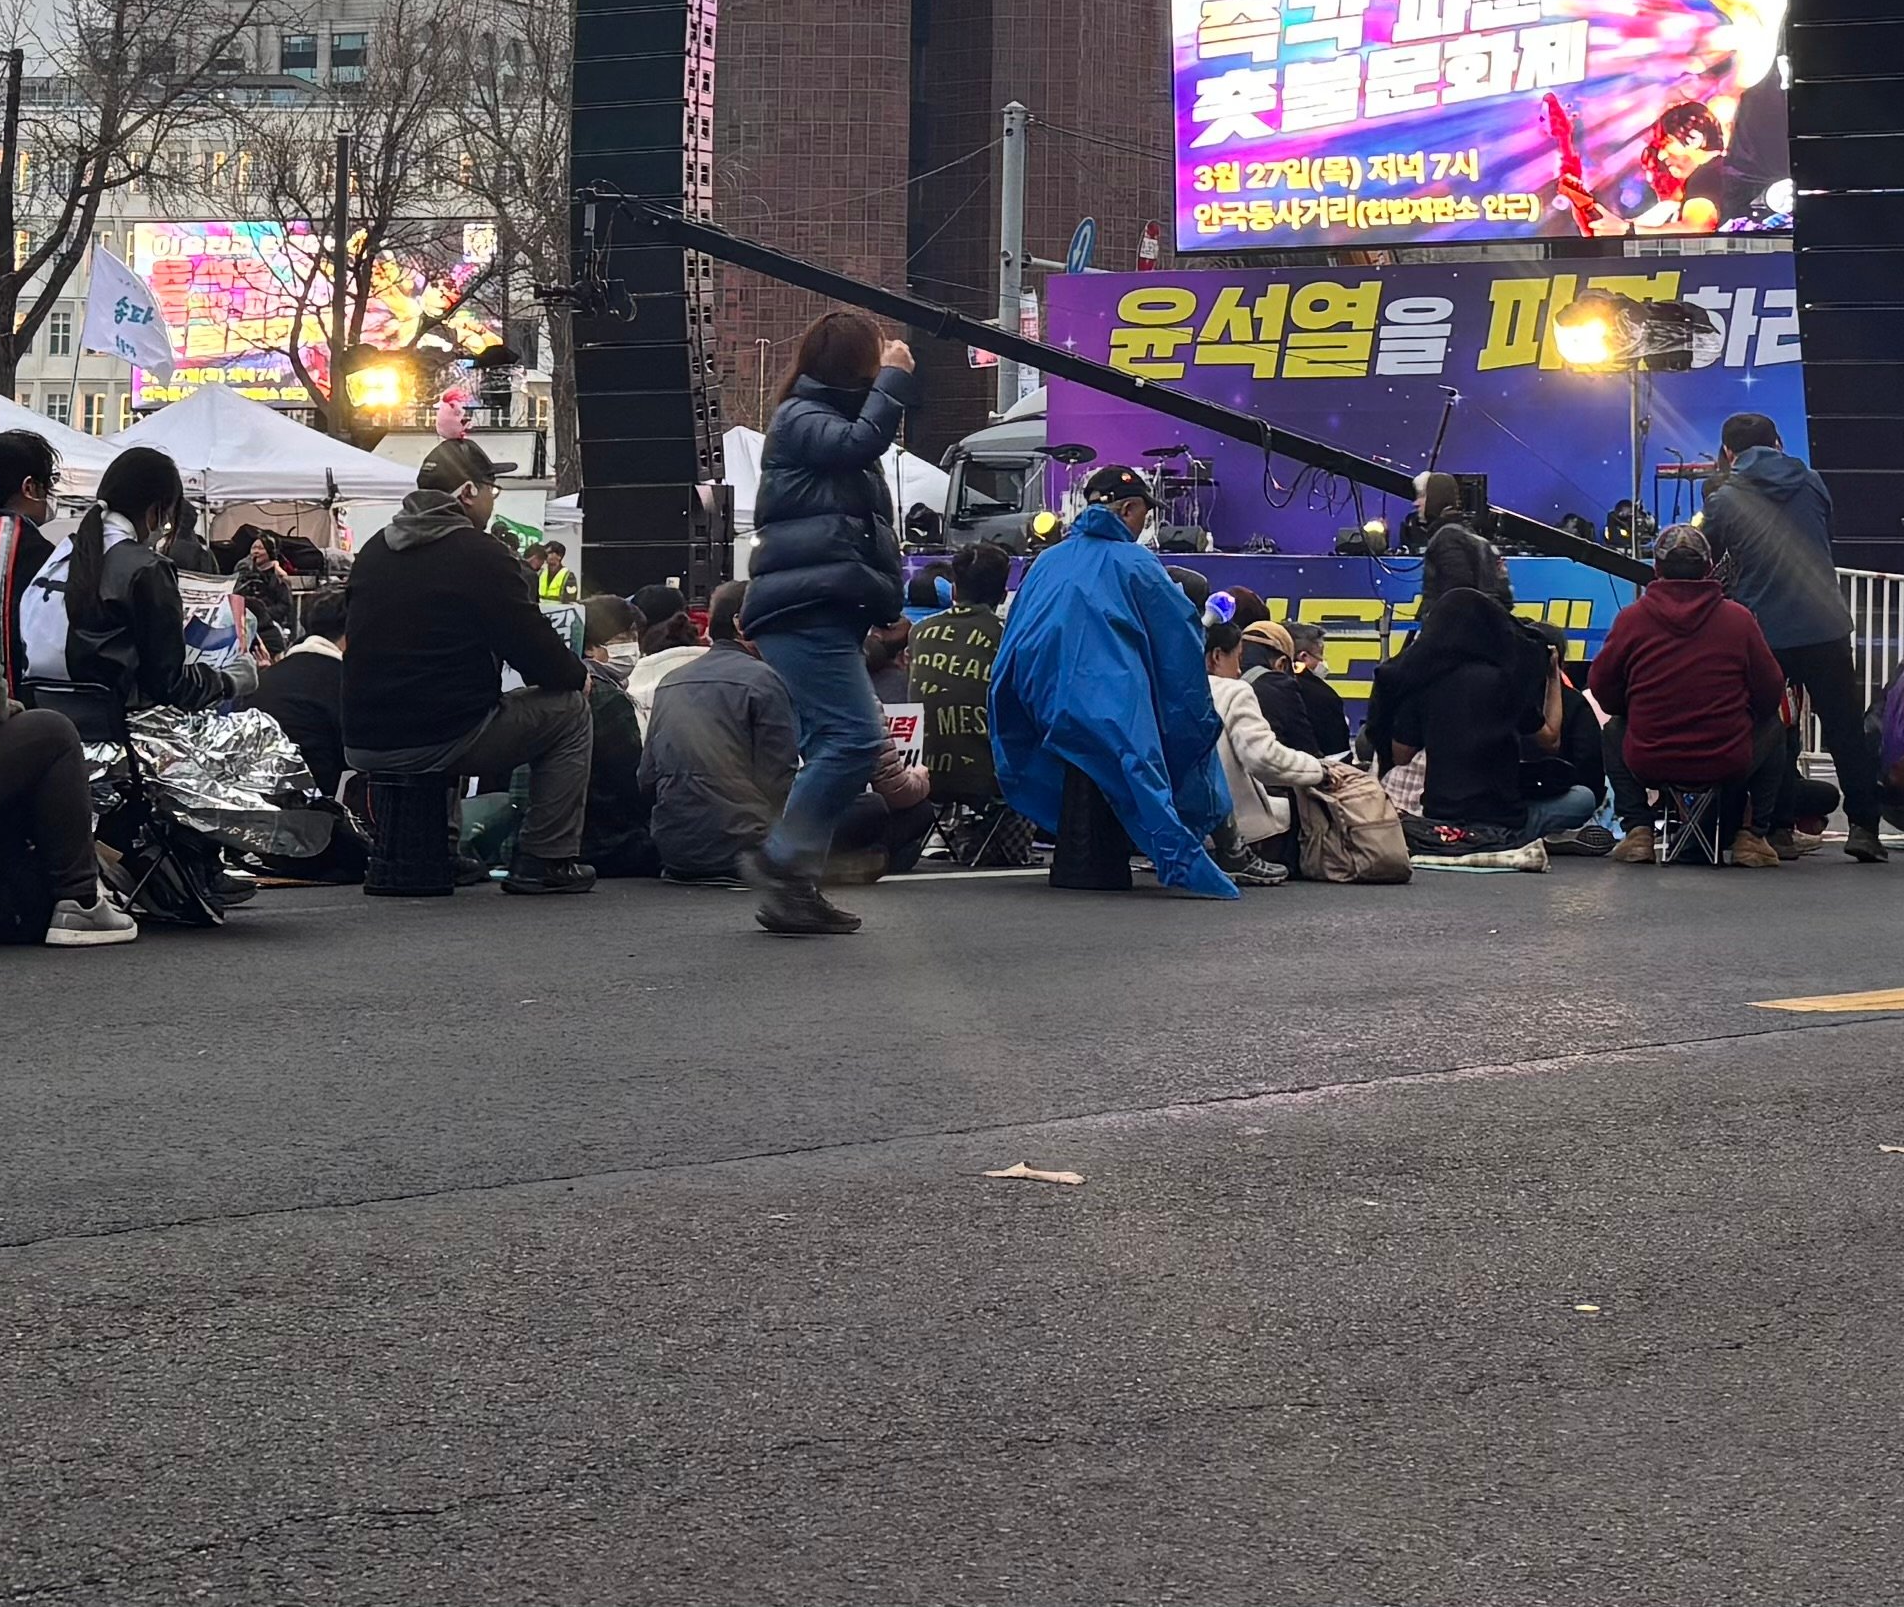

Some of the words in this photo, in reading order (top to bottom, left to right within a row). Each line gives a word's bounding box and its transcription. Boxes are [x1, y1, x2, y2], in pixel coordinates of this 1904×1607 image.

[1189, 20, 1589, 148] 촛불문화제
[1193, 161, 1241, 194] 3월
[1245, 155, 1363, 191] 27일(목)
[1367, 151, 1426, 184] 저녁
[1430, 148, 1480, 182] 7시
[1108, 280, 1455, 380] 윤석열을
